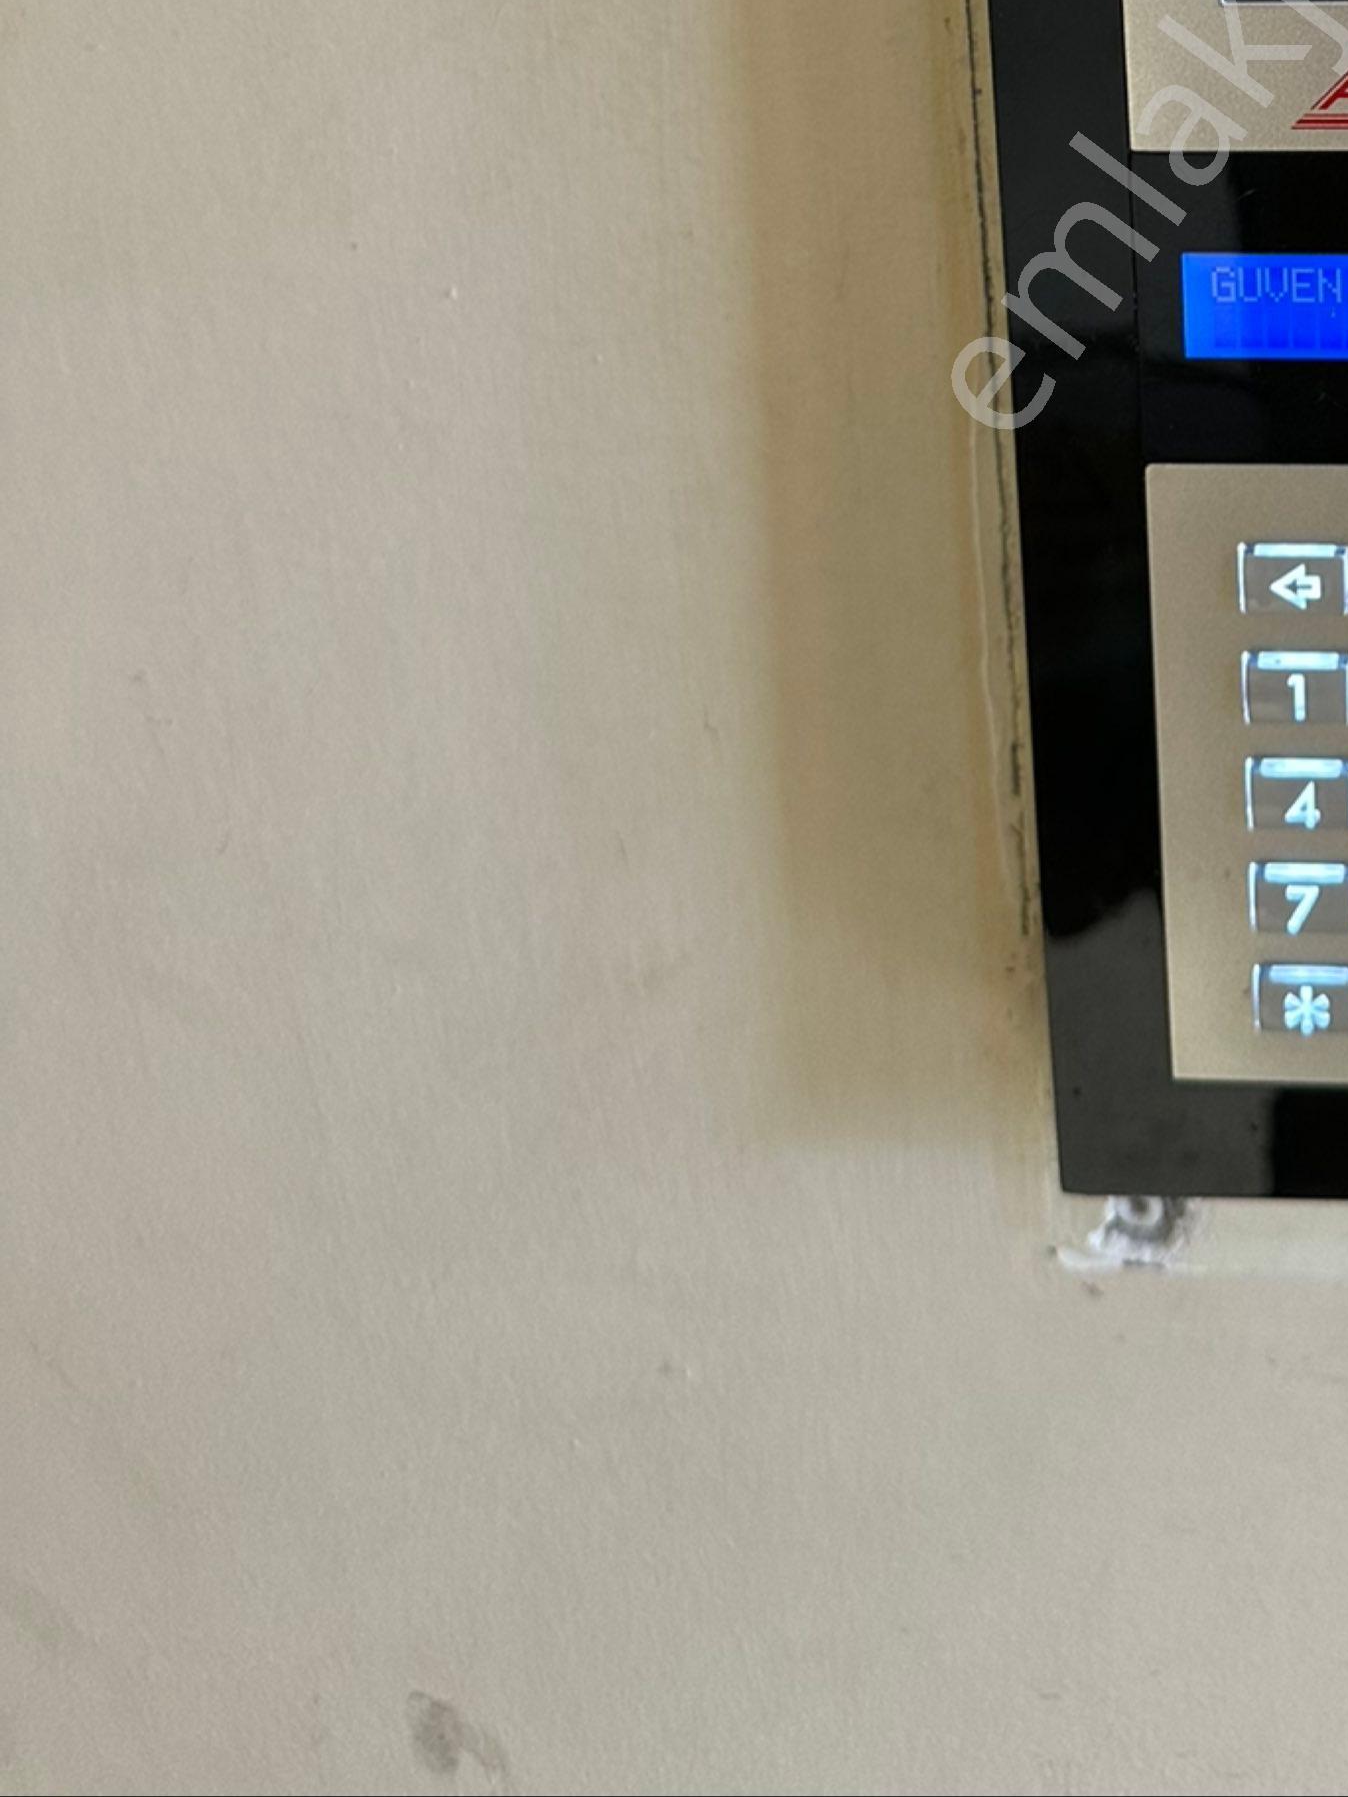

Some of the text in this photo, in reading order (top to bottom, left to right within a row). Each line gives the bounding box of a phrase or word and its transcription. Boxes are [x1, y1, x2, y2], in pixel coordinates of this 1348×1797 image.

[1286, 673, 1306, 721] 1
[1284, 781, 1321, 829] 4
[1284, 885, 1320, 935] 7
